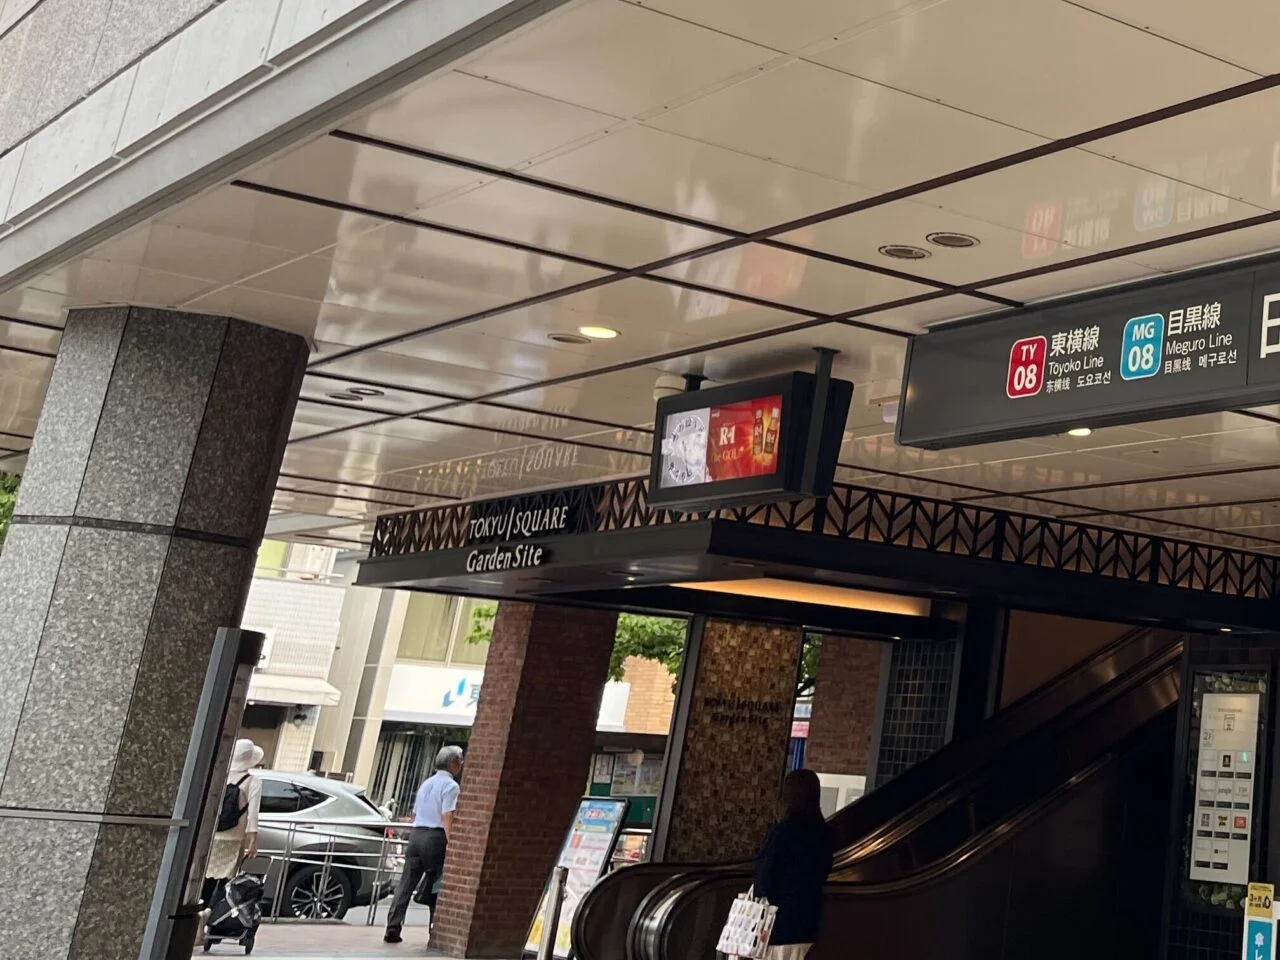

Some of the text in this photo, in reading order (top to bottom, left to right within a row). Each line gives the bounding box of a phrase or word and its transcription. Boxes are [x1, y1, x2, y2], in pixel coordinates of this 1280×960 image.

[1132, 321, 1155, 341] MG
[1167, 302, 1222, 337] 目黒線
[1021, 343, 1038, 362] TY
[1050, 325, 1100, 357] 東横線
[1166, 331, 1233, 356] Meguro Line
[1083, 354, 1104, 369] Line
[1128, 344, 1154, 372] 08
[1198, 349, 1237, 367] 메구로선
[1013, 364, 1037, 391] 08
[1076, 370, 1112, 388] 도요코선
[466, 544, 543, 573] Garden Site
